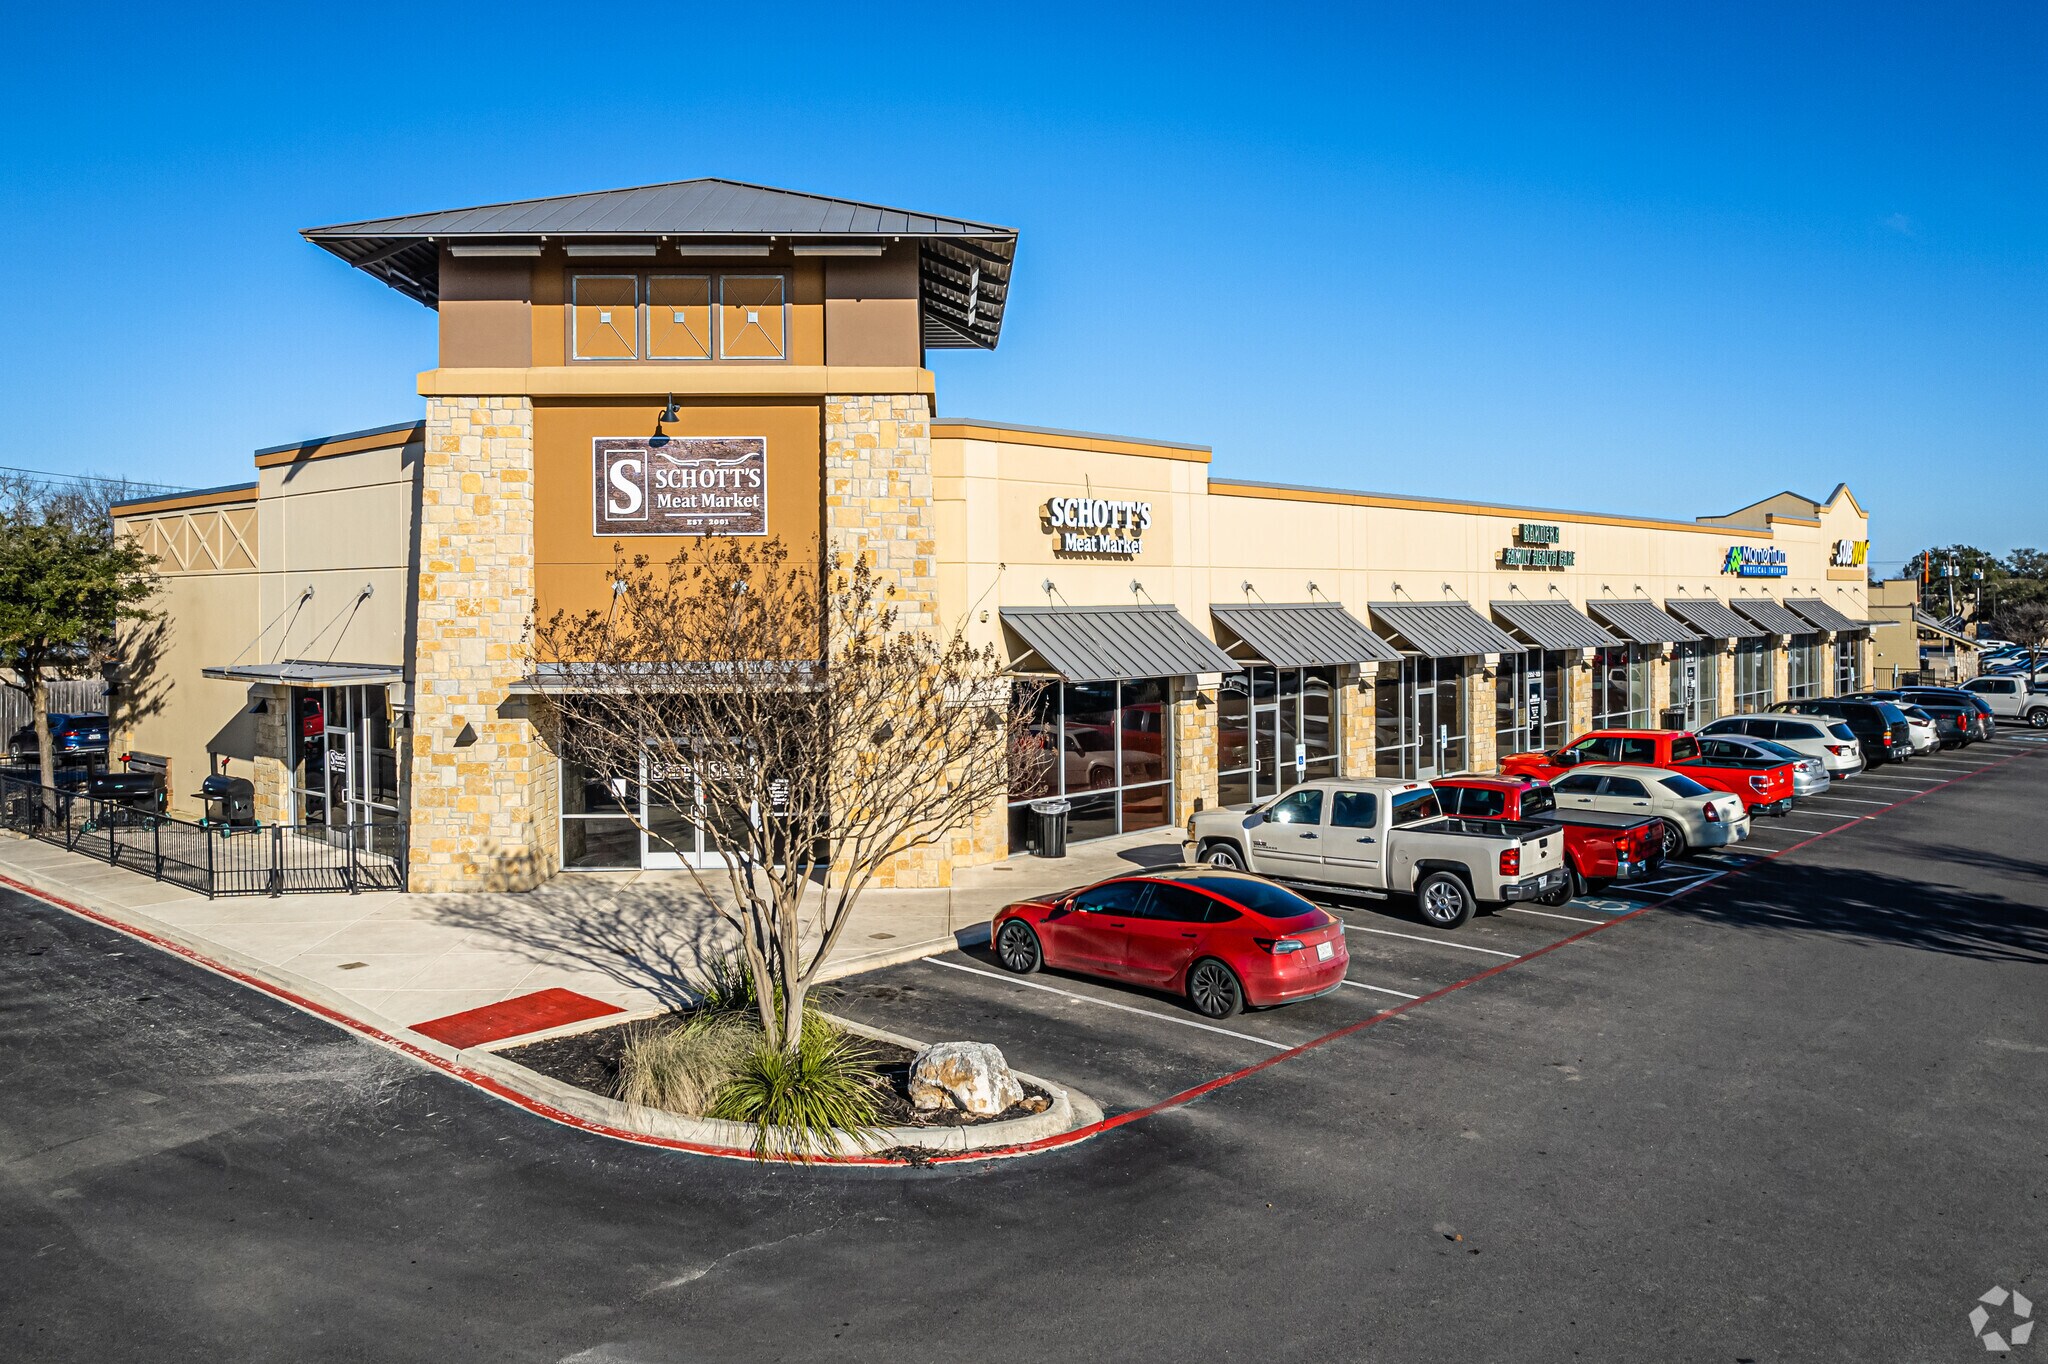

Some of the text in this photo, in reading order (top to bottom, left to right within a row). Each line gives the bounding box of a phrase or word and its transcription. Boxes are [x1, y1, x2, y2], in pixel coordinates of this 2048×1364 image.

[609, 459, 643, 514] S
[655, 468, 761, 488] SCHOTT'S
[657, 493, 760, 508] Meat Market
[1051, 496, 1152, 530] SCHOTT'S
[1065, 532, 1144, 554] Meat Market
[1836, 540, 1870, 564] SUBWAY
[1505, 548, 1575, 567] FAMILY HEALTH CARE
